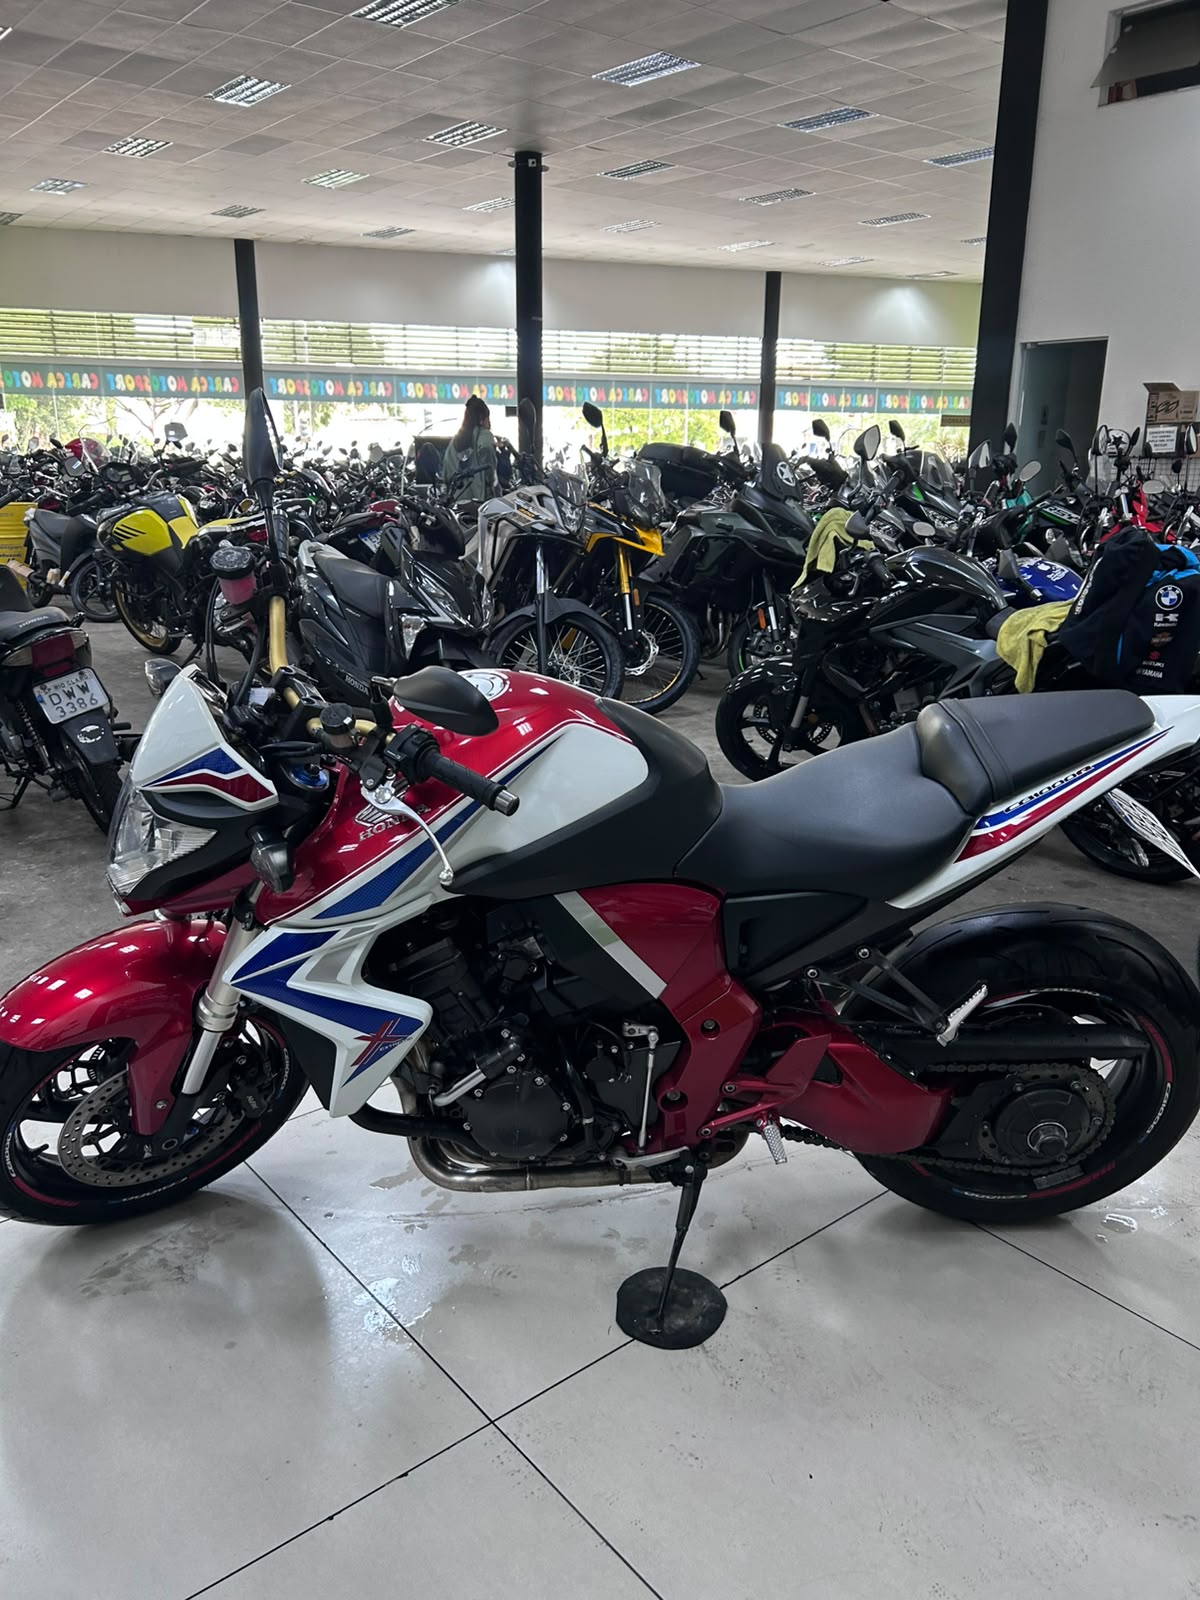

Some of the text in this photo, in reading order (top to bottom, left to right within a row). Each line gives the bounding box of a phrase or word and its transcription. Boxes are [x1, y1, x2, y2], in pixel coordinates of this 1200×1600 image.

[48, 681, 90, 706] DWW
[345, 674, 369, 696] HONDA
[56, 693, 98, 718] 3386
